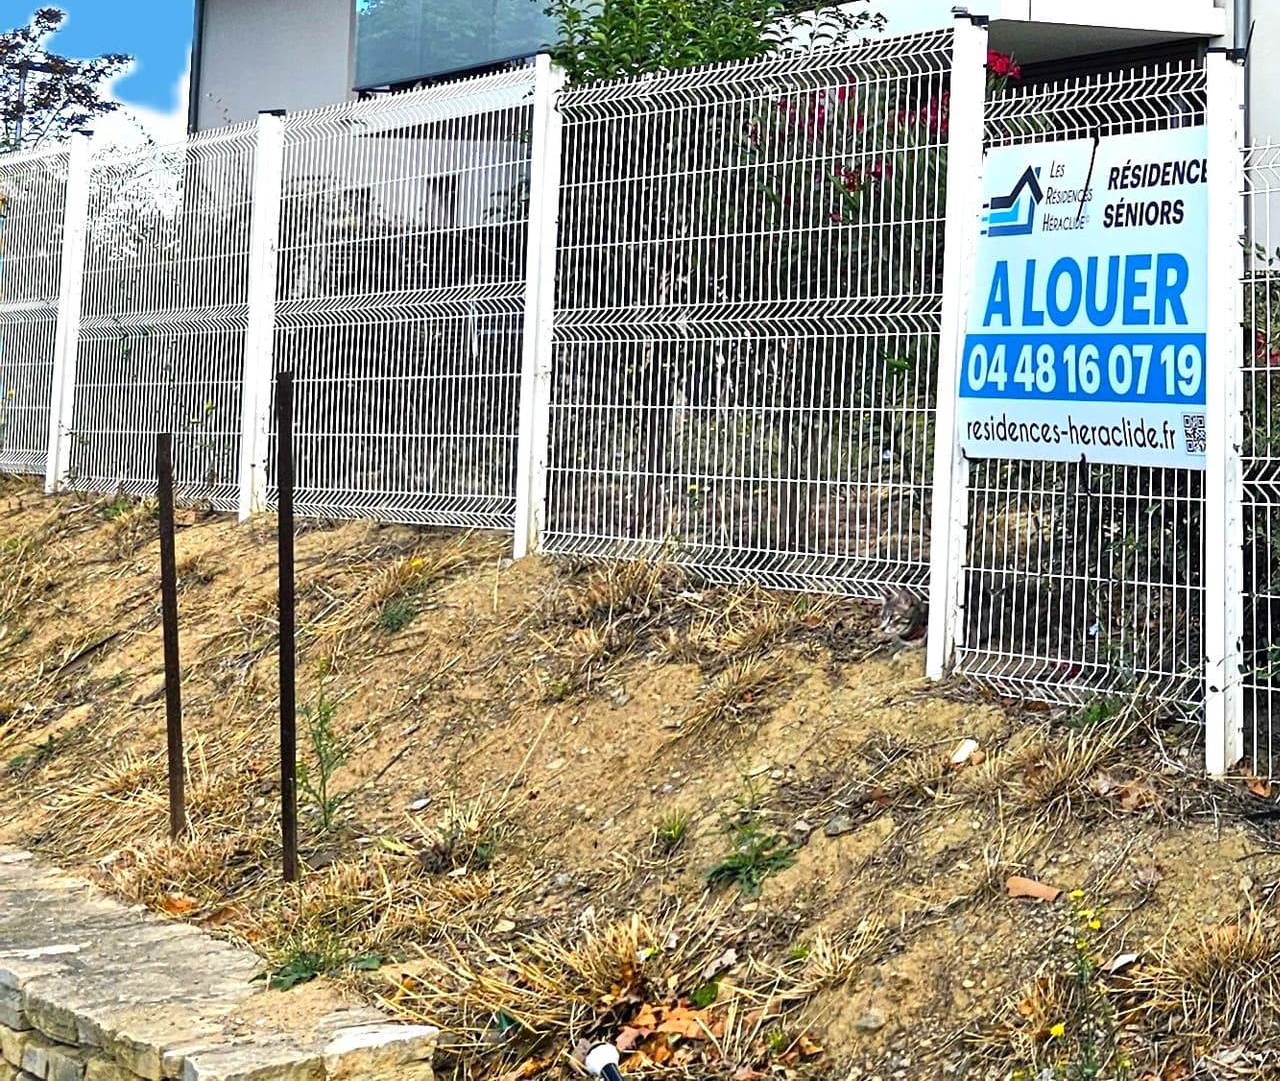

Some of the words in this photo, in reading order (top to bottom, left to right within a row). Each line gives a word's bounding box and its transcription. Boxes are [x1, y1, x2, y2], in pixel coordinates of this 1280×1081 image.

[1103, 197, 1184, 228] SÉNIORS
[982, 260, 1012, 327] A
[1022, 253, 1189, 327] LOUER
[967, 343, 1007, 392] 04
[1013, 344, 1056, 393] 48
[1063, 344, 1100, 394] 16
[1107, 344, 1153, 396] 07
[1160, 344, 1202, 397] 19
[967, 413, 1176, 450] residences-heraclide.fr
